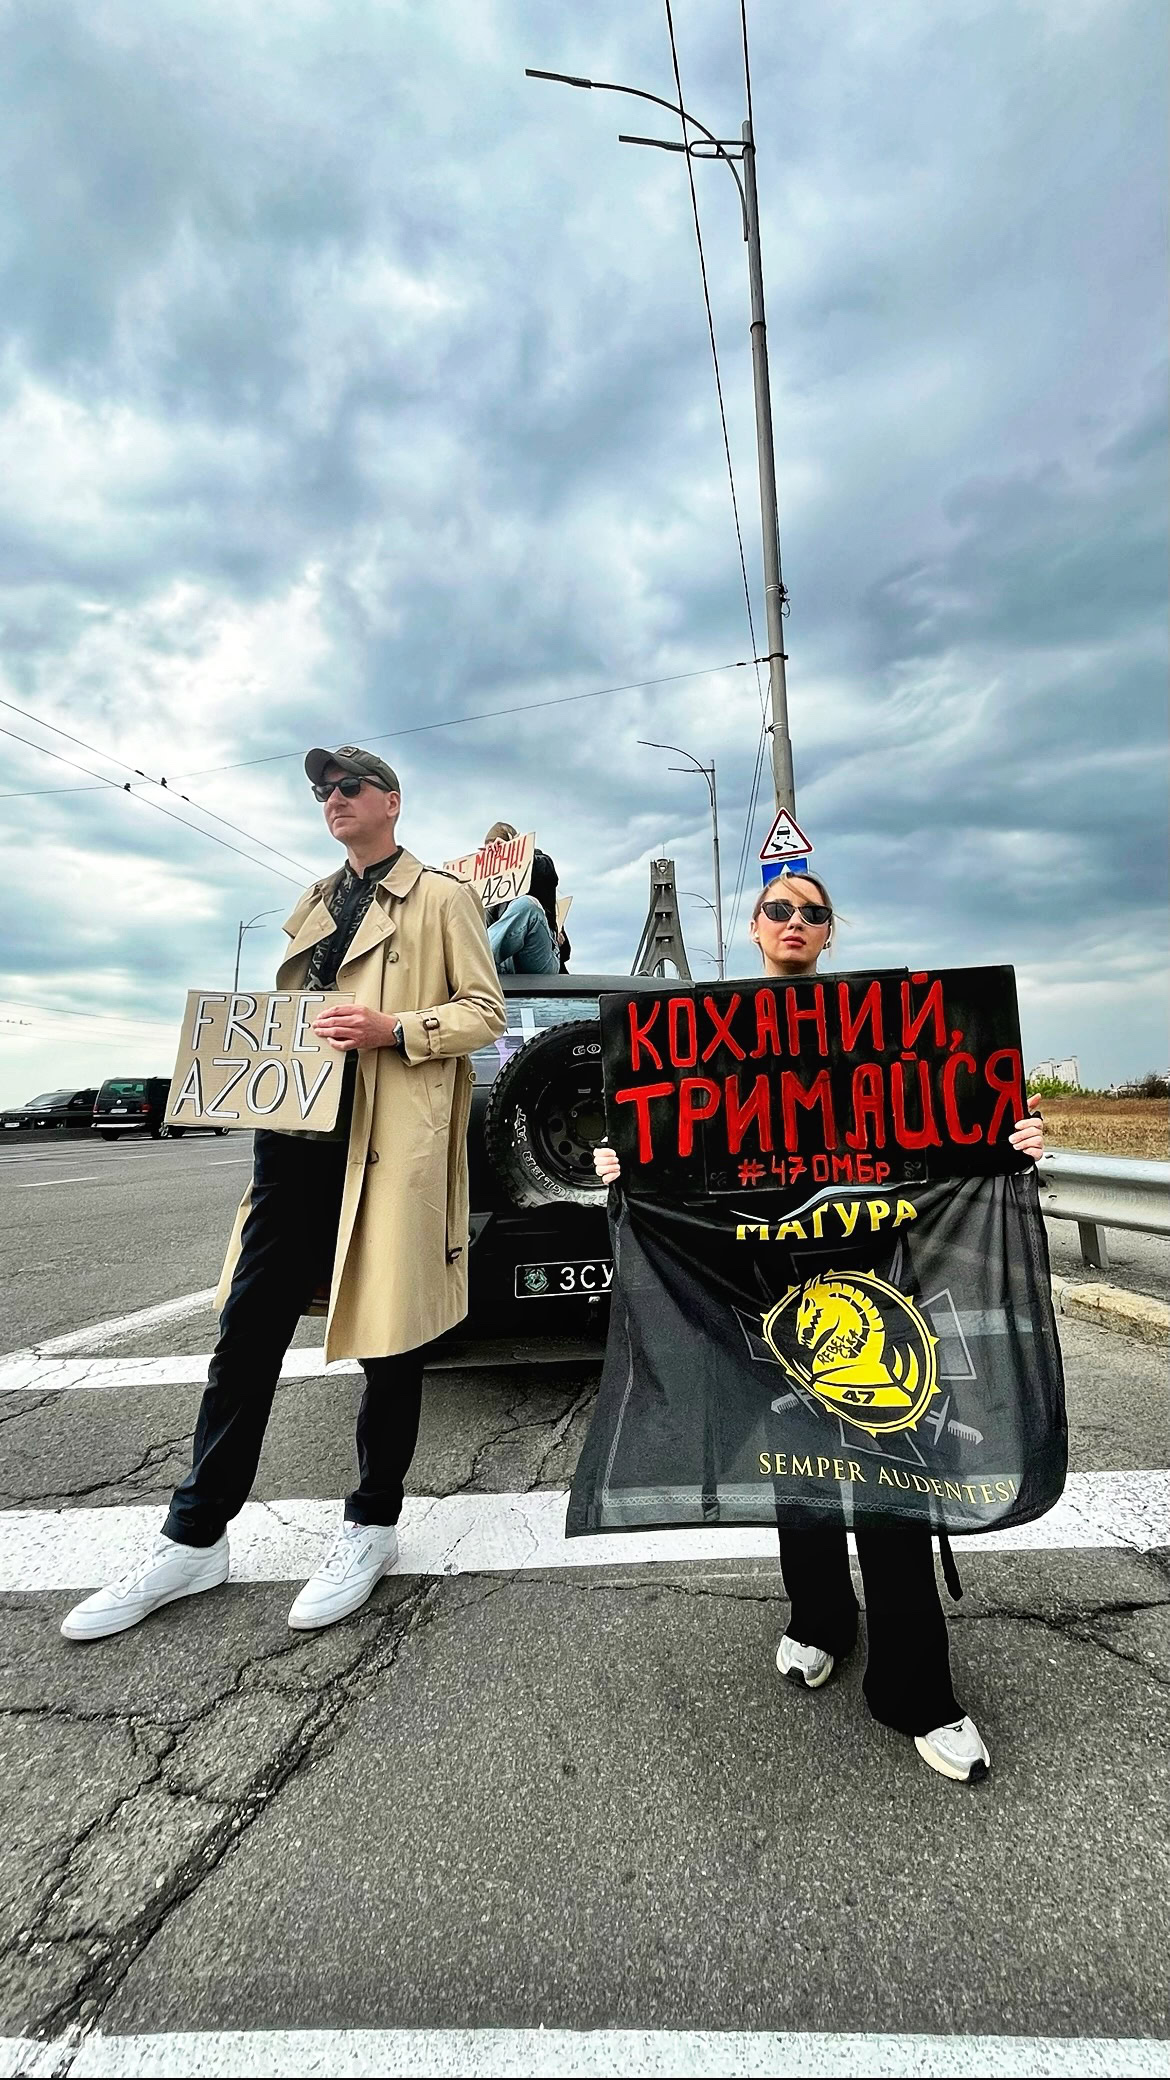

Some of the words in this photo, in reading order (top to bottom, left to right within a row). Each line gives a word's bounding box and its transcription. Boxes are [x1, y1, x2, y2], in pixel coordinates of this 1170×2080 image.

[481, 860, 532, 907] AZOV
[191, 995, 325, 1052] FREE
[628, 972, 964, 1071] КОХАНИЙ,
[572, 1043, 602, 1056] GO
[171, 1057, 333, 1120] AZOV
[615, 1049, 1025, 1164] ТРИМАЙСЯ
[816, 1334, 845, 1365] REBEL
[841, 1390, 876, 1405] 47
[758, 1452, 867, 1483] SEMPER
[877, 1466, 1018, 1504] AUDENTES!
